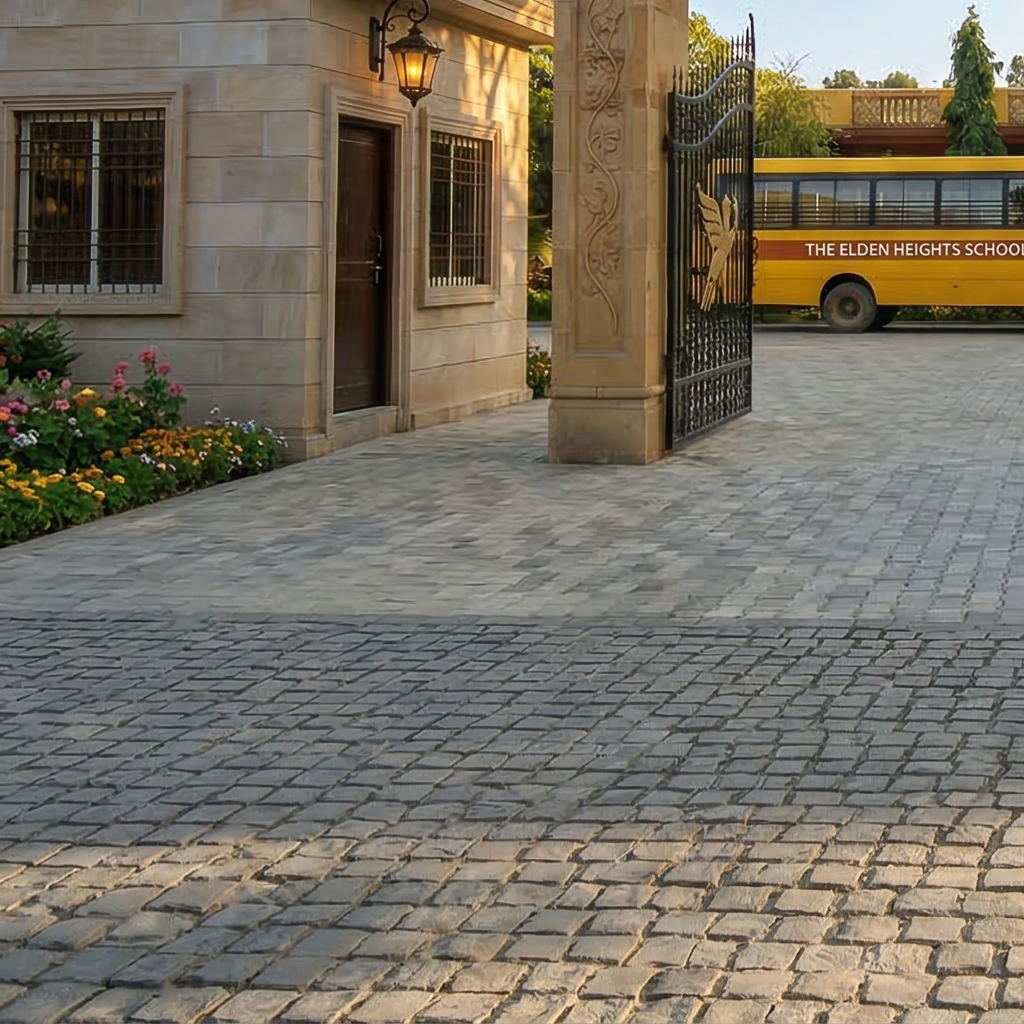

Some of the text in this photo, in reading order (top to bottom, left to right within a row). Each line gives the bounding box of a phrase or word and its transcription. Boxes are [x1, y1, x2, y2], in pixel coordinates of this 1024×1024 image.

[805, 242, 835, 257] THE
[839, 242, 889, 257] ELDEN
[893, 242, 961, 257] HEIGHTS
